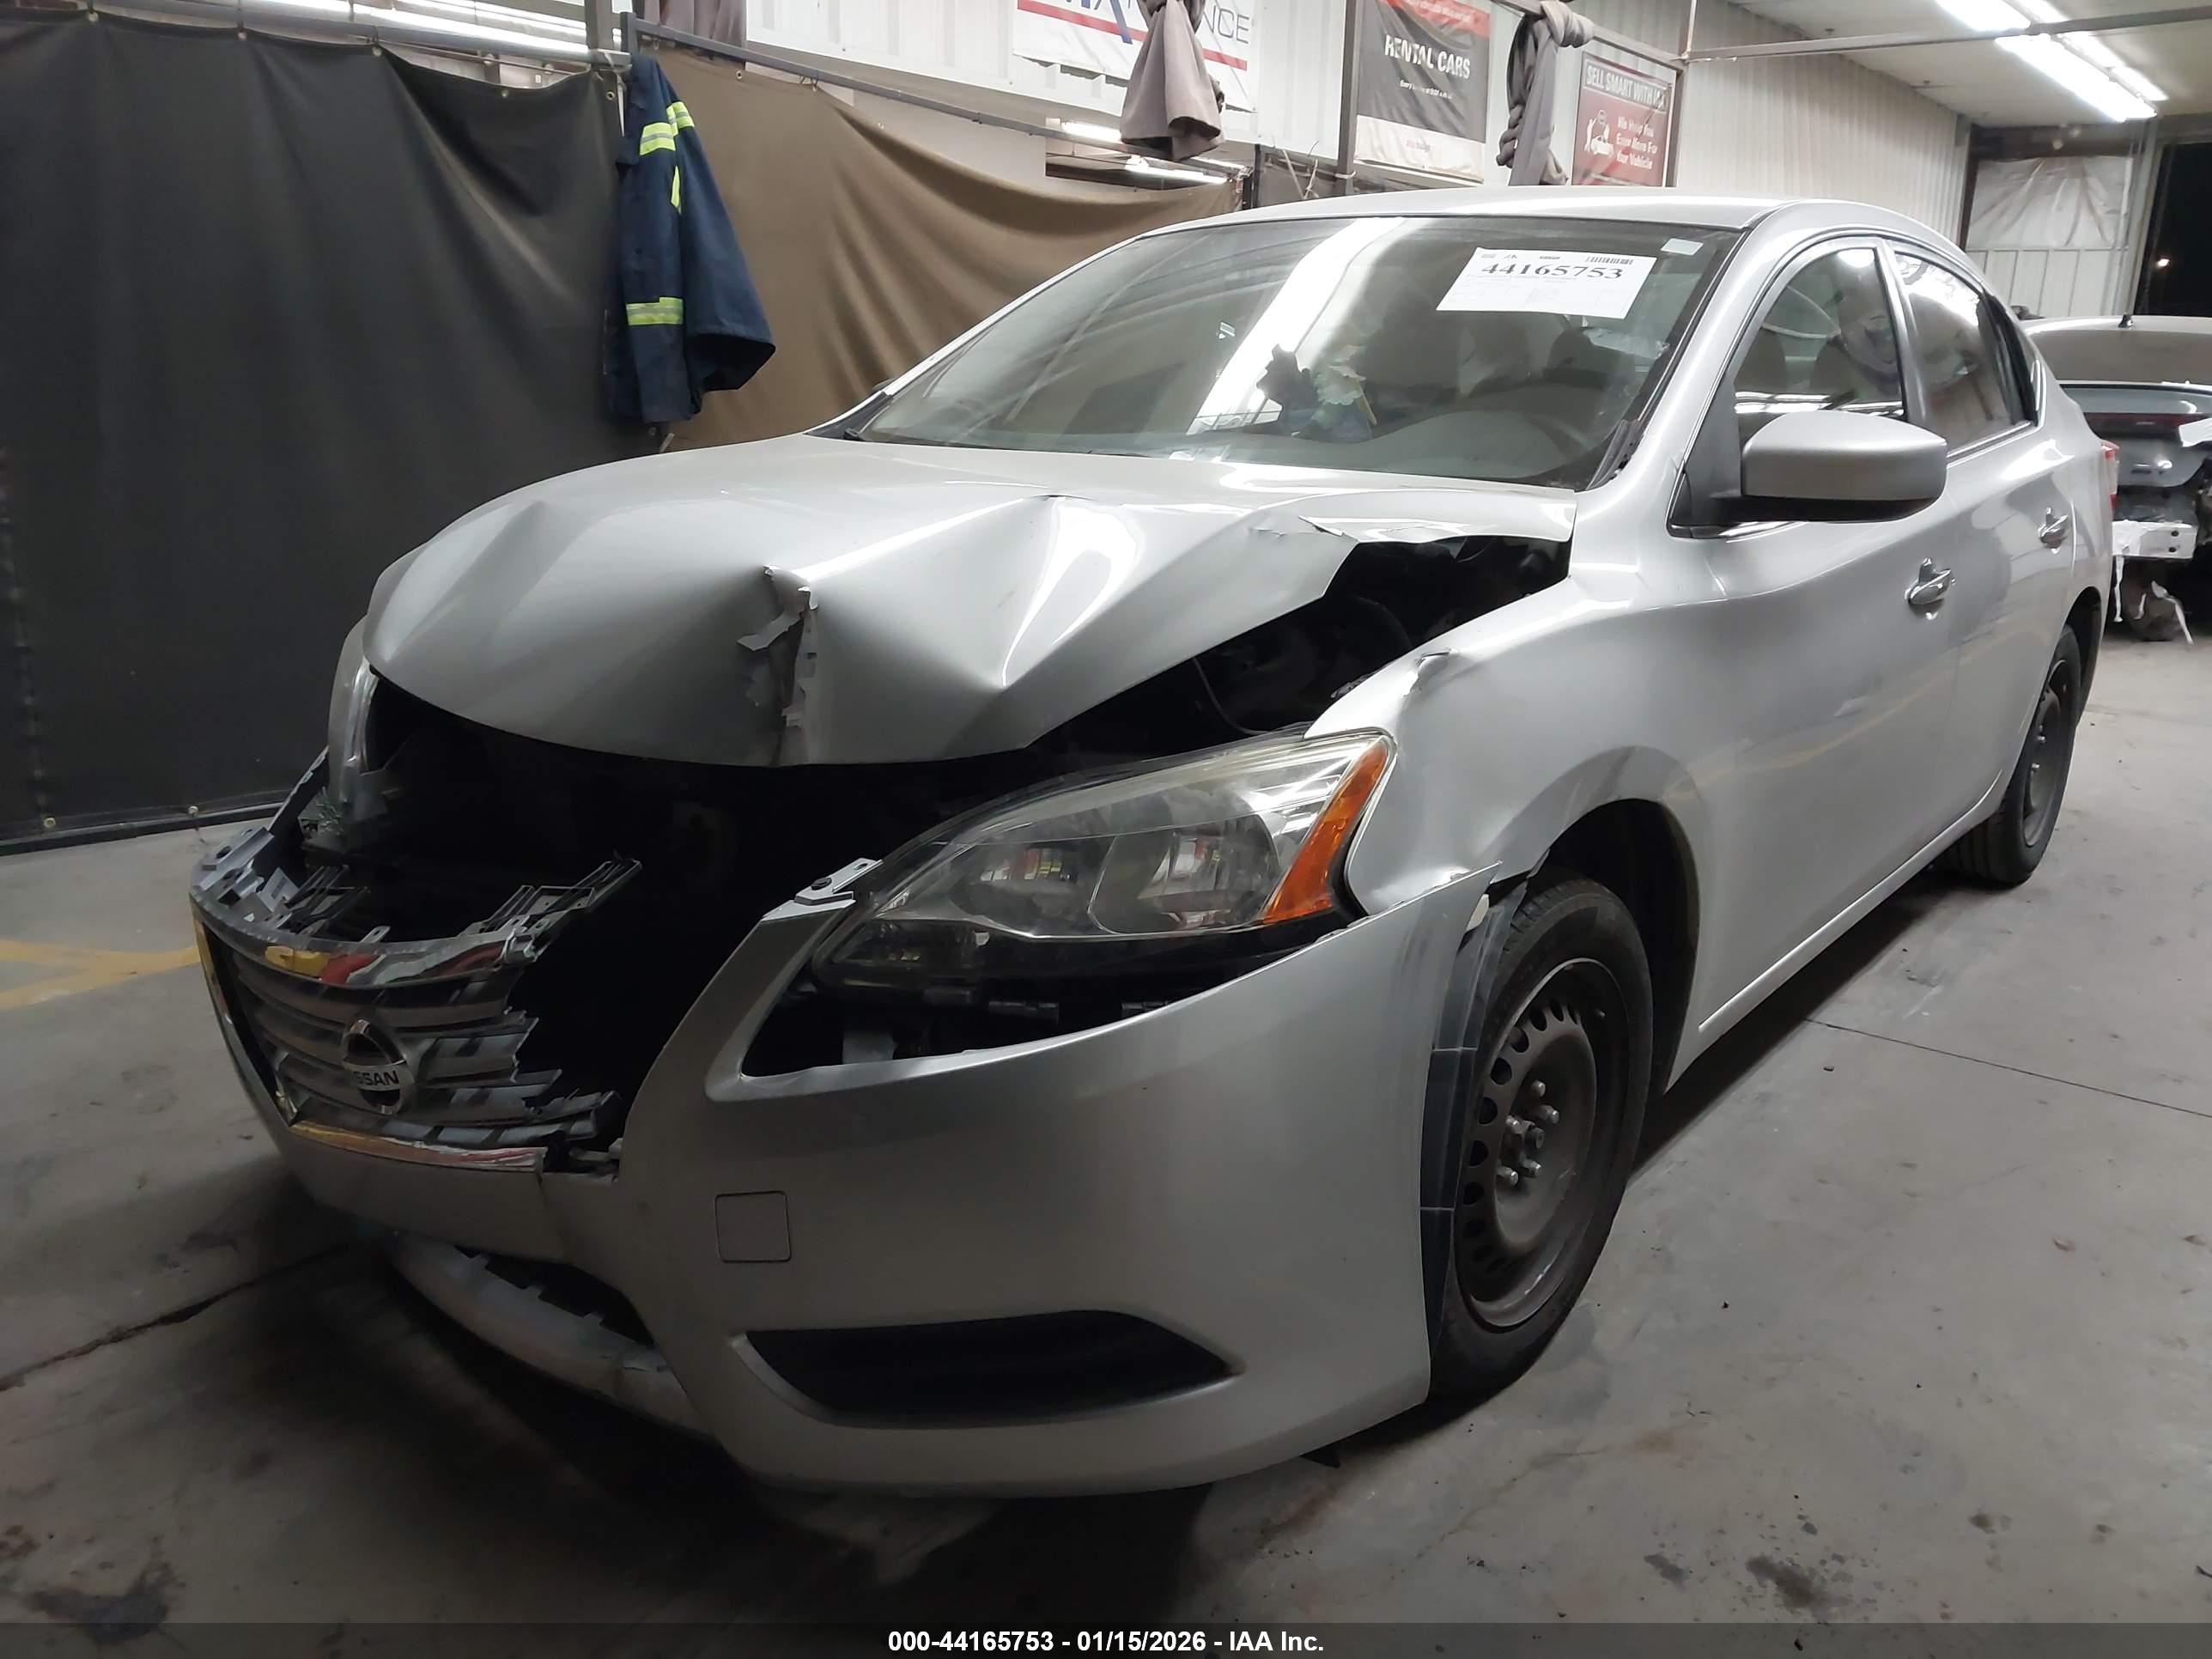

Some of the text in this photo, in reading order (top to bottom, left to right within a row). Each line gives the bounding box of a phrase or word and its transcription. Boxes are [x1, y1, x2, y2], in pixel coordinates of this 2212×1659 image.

[1384, 34, 1470, 79] RENTAL CARS
[1586, 65, 1605, 88] SELL
[1606, 72, 1632, 98] SMART
[1633, 82, 1653, 104] WITH
[1648, 141, 1658, 155] For
[1481, 263, 1623, 279] 44165753
